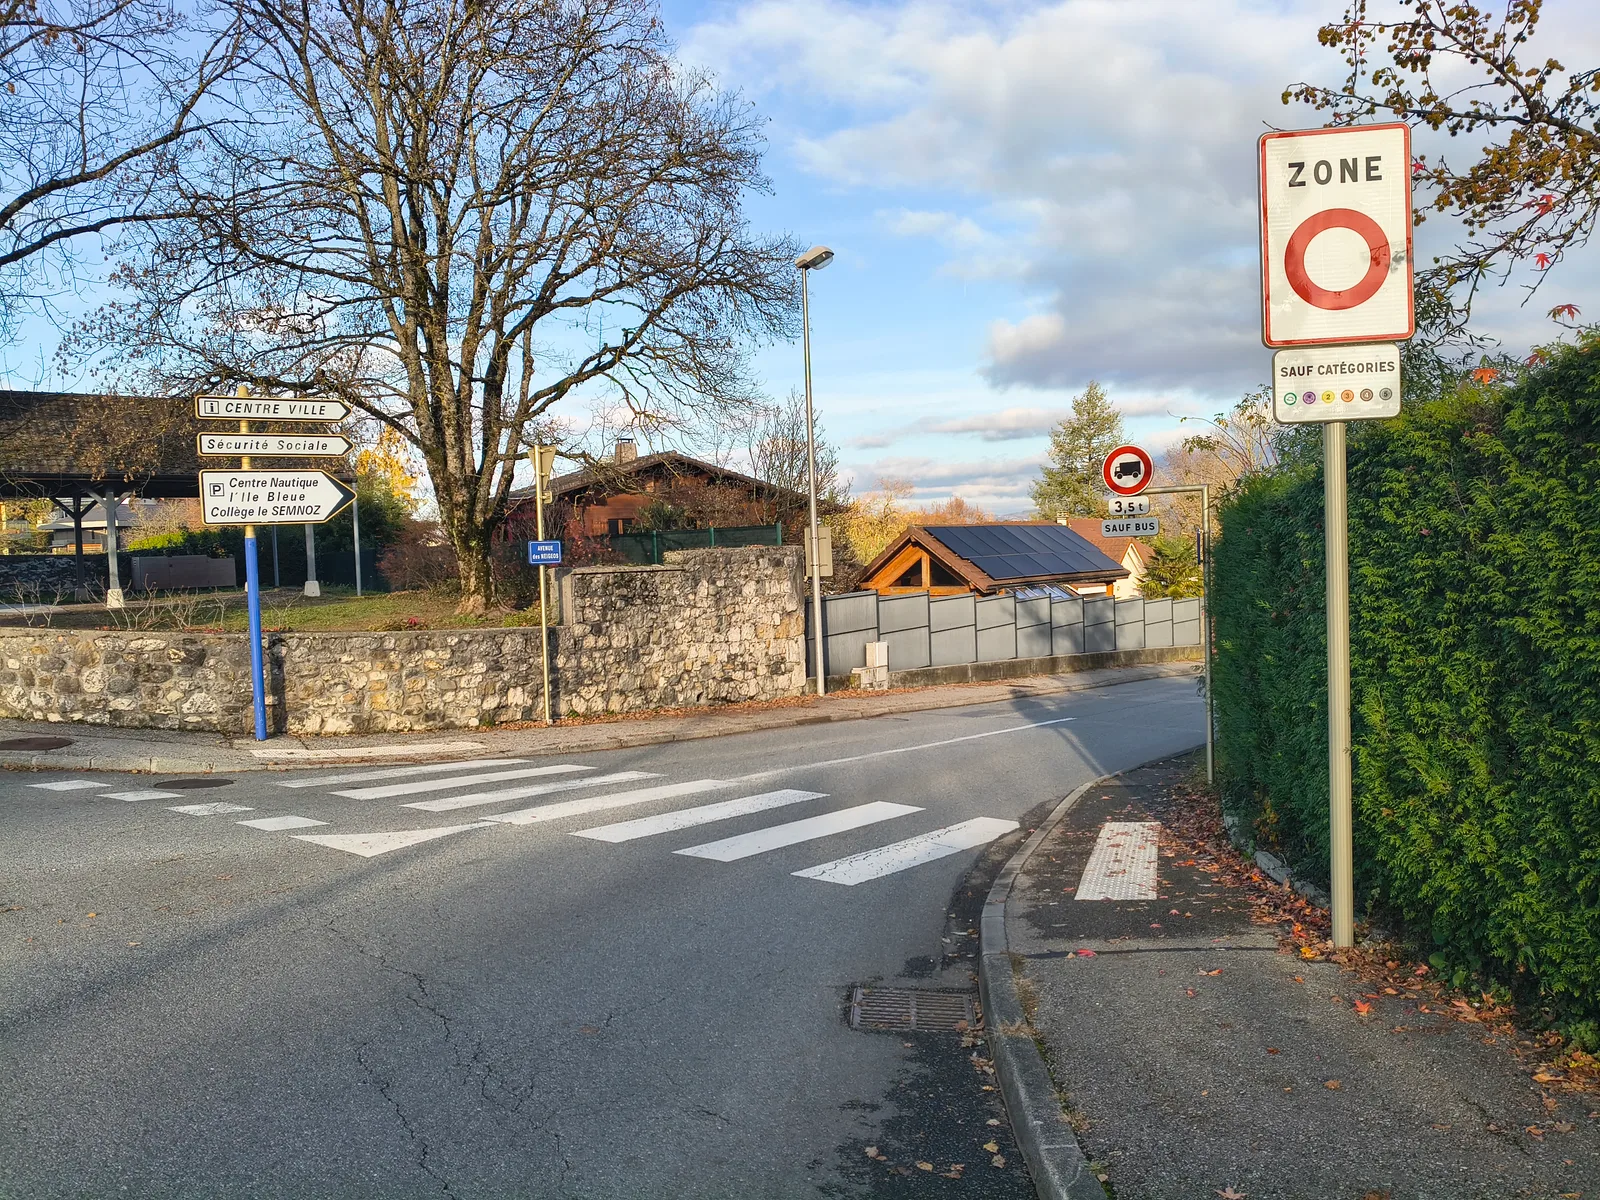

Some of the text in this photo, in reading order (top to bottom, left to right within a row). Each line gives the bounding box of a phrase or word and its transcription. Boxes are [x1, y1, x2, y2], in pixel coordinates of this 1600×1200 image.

[1288, 156, 1383, 188] ZONE
[1280, 360, 1395, 377] SAUF CATÉGORIES
[225, 402, 280, 414] CENTRE
[289, 404, 326, 415] VILLE
[207, 438, 328, 451] Sécurité Sociale
[229, 477, 318, 489] Centre Nautique
[267, 491, 306, 502] Bleue
[211, 505, 321, 519] Collège le SEMNOZ
[1115, 501, 1143, 513] 3,5 t
[1104, 522, 1155, 532] SAUF BUS
